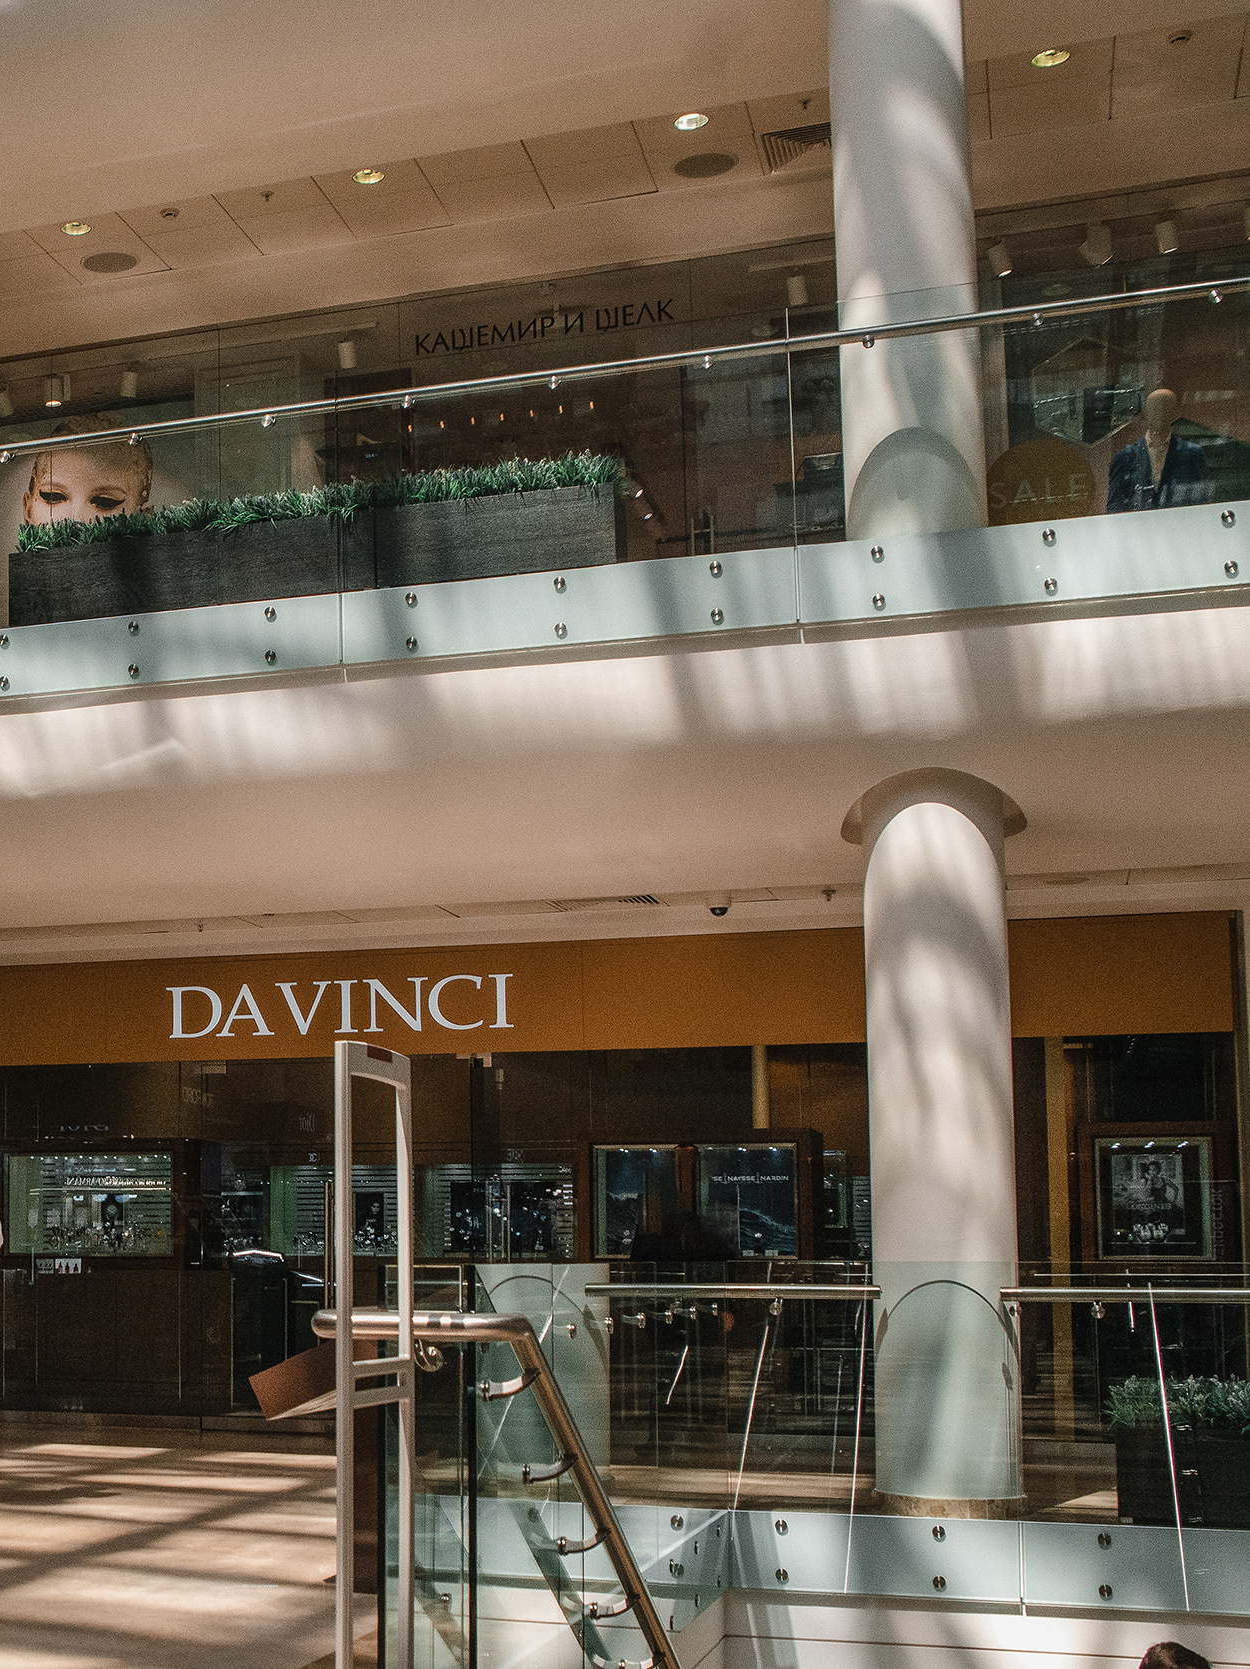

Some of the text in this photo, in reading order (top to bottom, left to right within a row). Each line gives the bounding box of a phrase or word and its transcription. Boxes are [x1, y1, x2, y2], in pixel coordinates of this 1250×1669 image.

[415, 298, 675, 356] КАШЕМИР И ШЕЛК
[990, 473, 1089, 509] SALE
